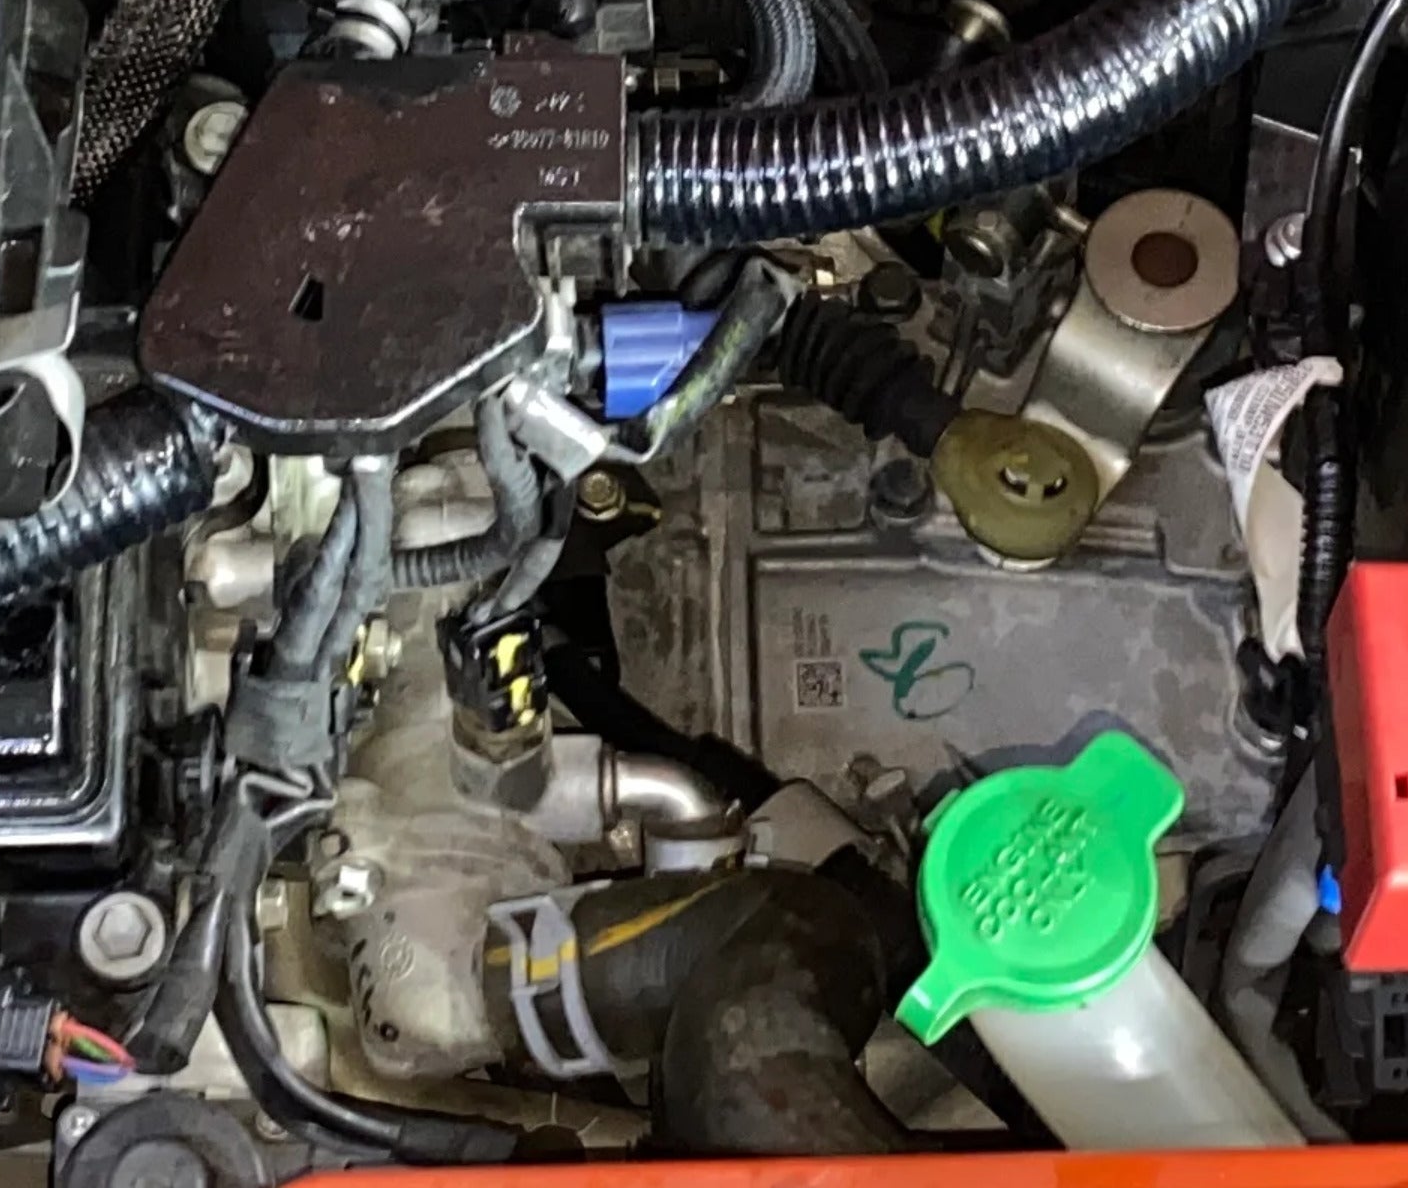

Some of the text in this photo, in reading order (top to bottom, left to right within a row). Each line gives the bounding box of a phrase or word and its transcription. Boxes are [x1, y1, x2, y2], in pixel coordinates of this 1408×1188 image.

[959, 798, 1066, 914] ENGINE
[976, 808, 1097, 943] COOLANT
[1024, 854, 1096, 935] ONLY
